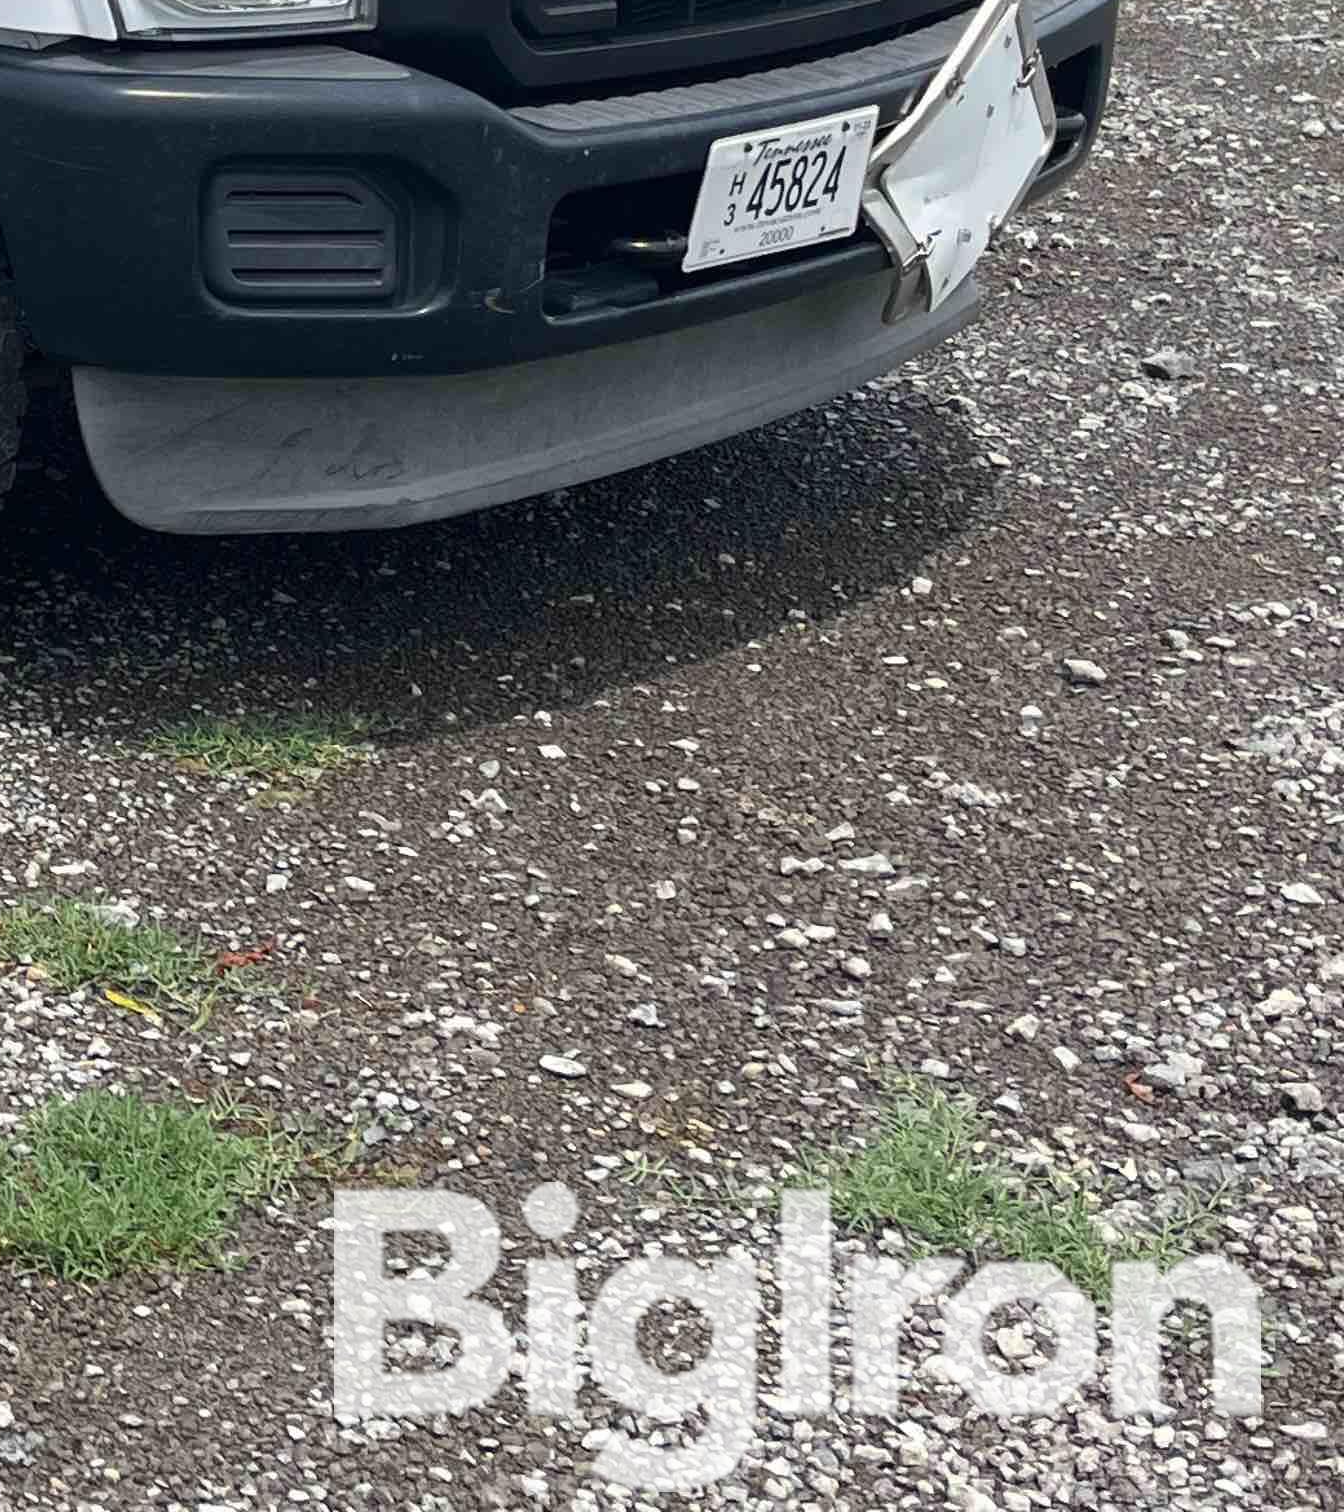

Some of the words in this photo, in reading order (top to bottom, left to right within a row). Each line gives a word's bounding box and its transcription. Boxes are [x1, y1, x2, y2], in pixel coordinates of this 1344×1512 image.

[752, 133, 833, 167] Tennessee
[728, 171, 748, 197] H
[745, 145, 848, 221] 45824
[723, 203, 737, 227] 3
